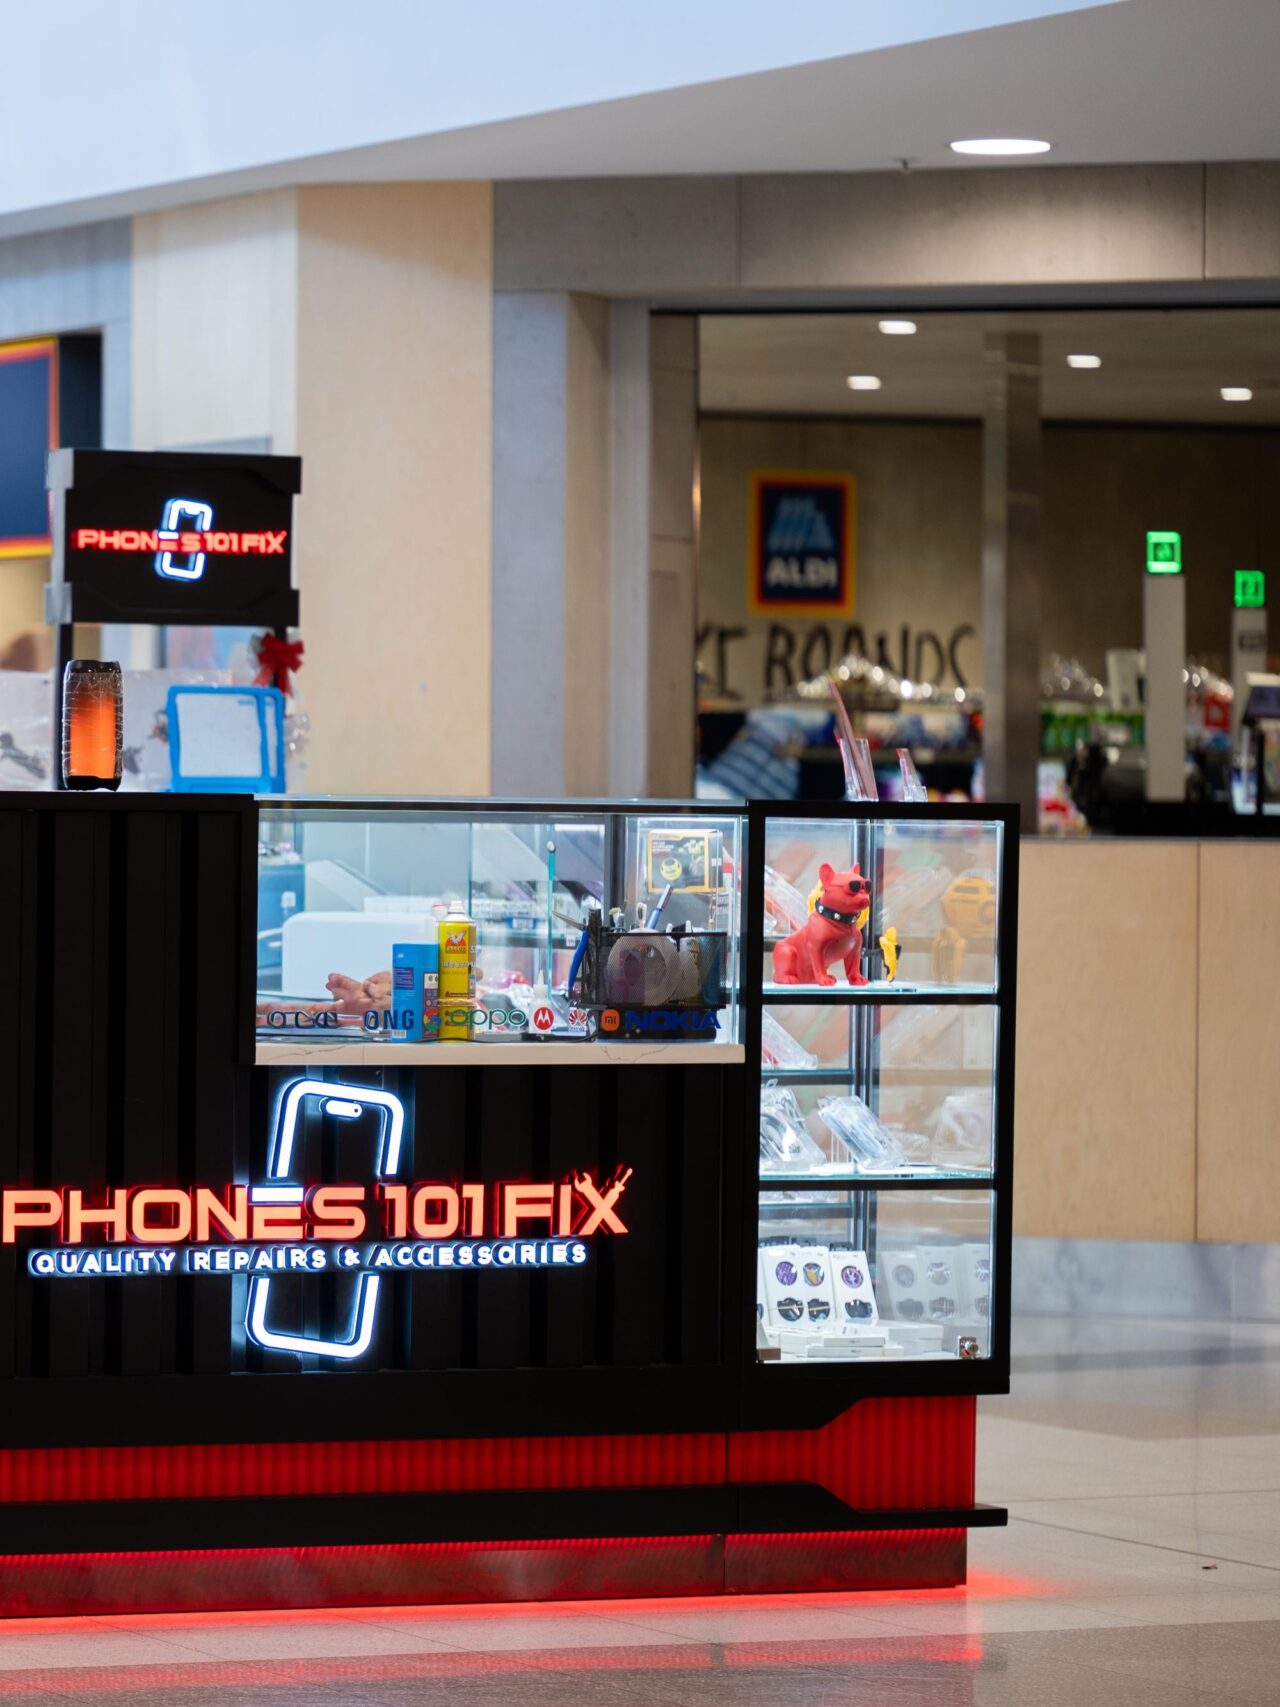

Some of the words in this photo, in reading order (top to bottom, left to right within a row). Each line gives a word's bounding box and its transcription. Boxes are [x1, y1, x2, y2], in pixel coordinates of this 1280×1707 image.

[76, 528, 201, 552] PHONES
[205, 532, 239, 552] 101
[241, 531, 287, 554] FIX
[766, 555, 839, 588] ALDI
[449, 1008, 527, 1031] oppo
[624, 1009, 722, 1030] NOKIA
[379, 1182, 486, 1240] 101
[499, 1167, 633, 1240] FIX
[29, 1250, 177, 1276] QUALITY
[184, 1248, 328, 1273] REPAIRS
[338, 1247, 361, 1270] &
[368, 1243, 589, 1270] ACCESSORIES
